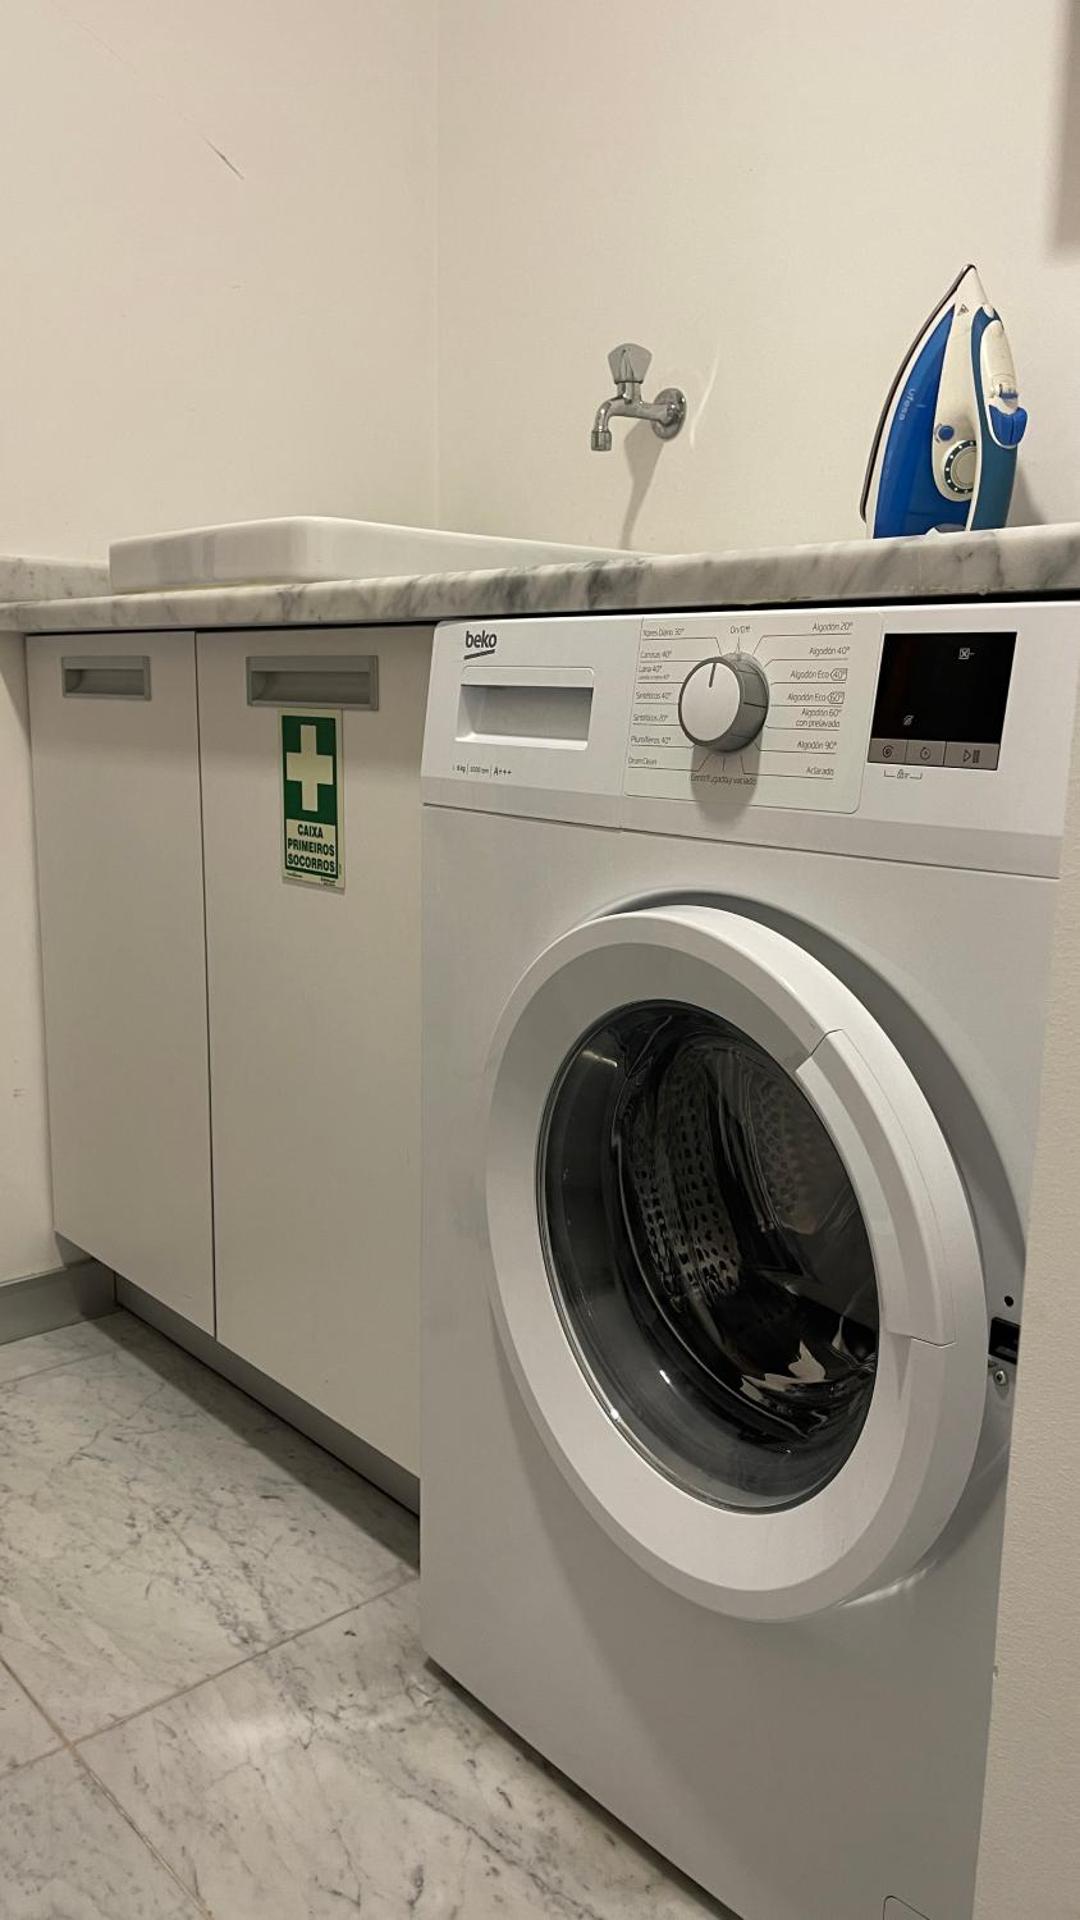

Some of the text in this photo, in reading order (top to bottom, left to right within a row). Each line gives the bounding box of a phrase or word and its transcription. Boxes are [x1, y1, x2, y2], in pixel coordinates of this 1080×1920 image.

[812, 622, 839, 632] Algodón
[465, 630, 498, 648] beko
[809, 647, 836, 657] Algodón
[790, 670, 816, 680] Algodón
[787, 693, 814, 703] Algodón
[297, 823, 324, 839] CAIXA
[287, 837, 335, 857] PRIMEIROS
[287, 853, 335, 873] SOCORROS
